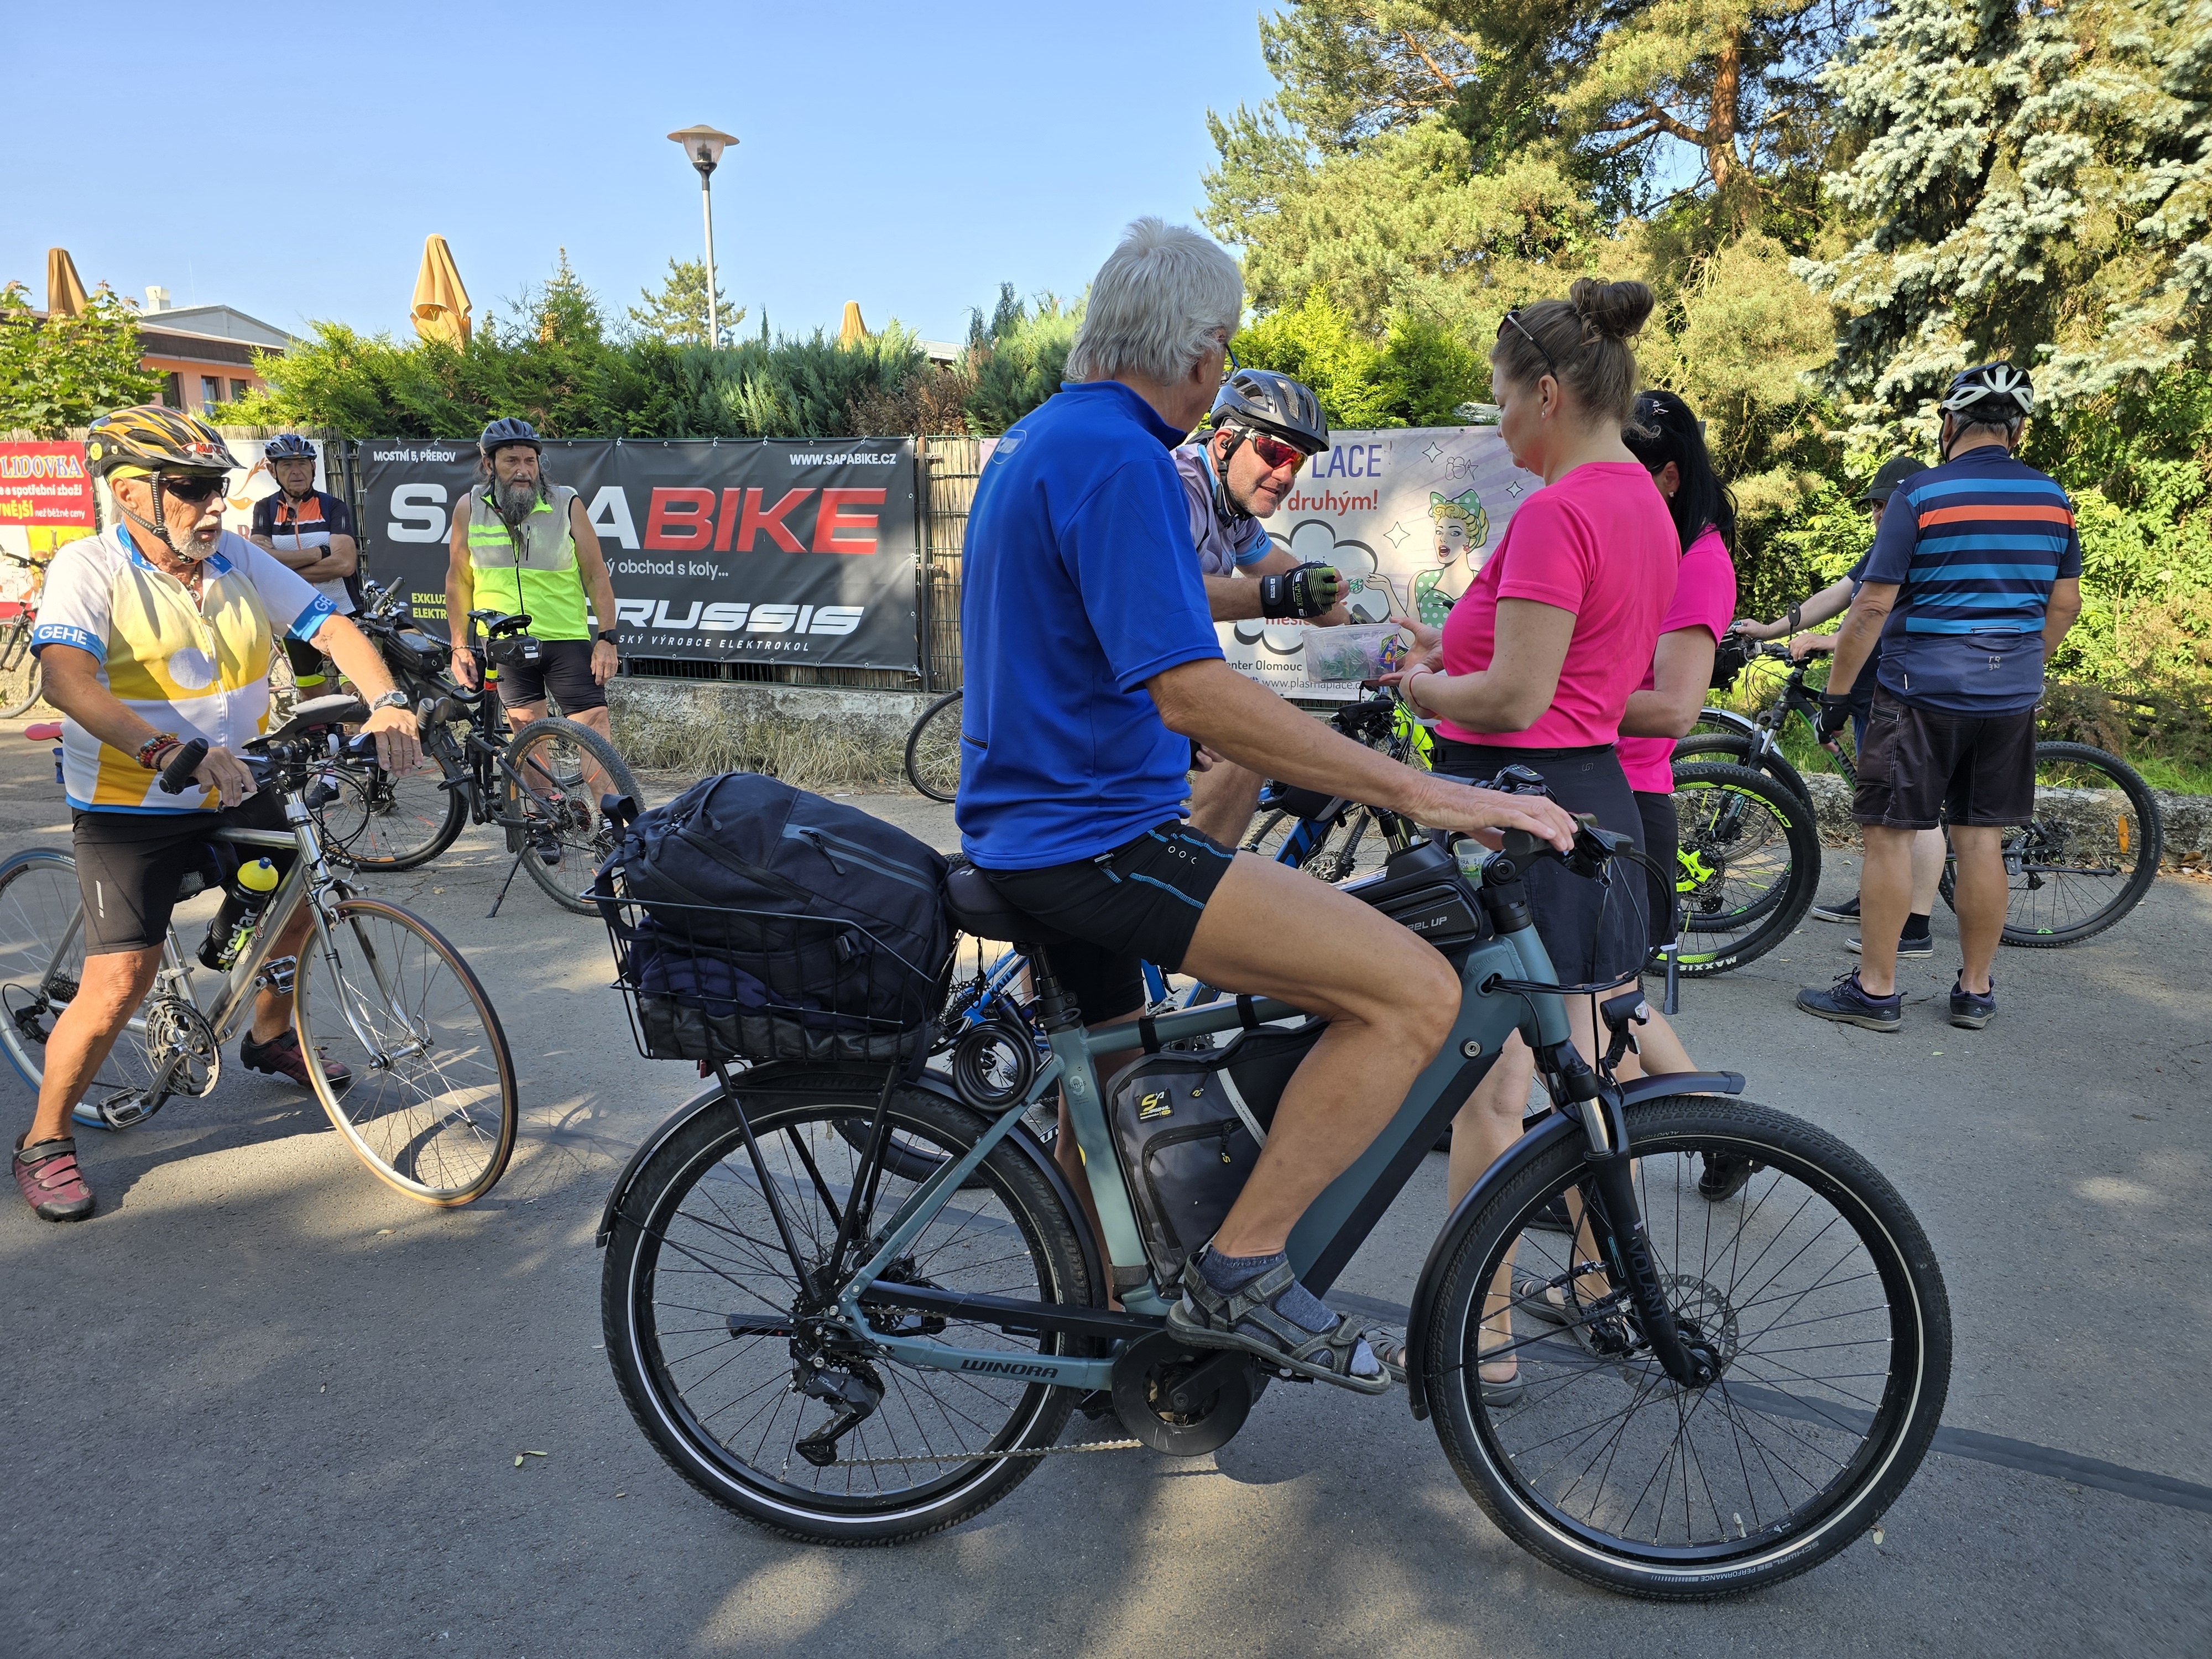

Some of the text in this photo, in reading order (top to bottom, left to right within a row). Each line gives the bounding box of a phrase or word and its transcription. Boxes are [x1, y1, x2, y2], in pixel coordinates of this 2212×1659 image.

[373, 448, 456, 463] MOSTNÍ 5, PŘEROV
[790, 453, 896, 465] WWW.SAPABIKE.CZ
[1295, 444, 1383, 479] LACE
[1, 455, 84, 478] LIDOVKA
[12, 483, 55, 498] spotřební
[57, 483, 82, 496] zboží
[0, 499, 85, 520] NĚJŠÍ než běžné ceny
[1287, 489, 1378, 516] druhým!
[618, 559, 674, 575] obchod
[677, 565, 686, 576] s
[688, 561, 729, 581] koly...
[411, 592, 447, 604] EXKLUZ
[413, 607, 449, 619] ELEKTR
[38, 626, 87, 645] GEHE
[618, 633, 809, 652] SKÝ VÝROBCE ELEKTROKOL
[1256, 660, 1302, 671] Olomouc
[1431, 916, 1447, 927] UP
[1679, 956, 1736, 971] MAXXIS
[1068, 1081, 1087, 1089] sinus
[960, 1359, 1058, 1379] WINORA
[1700, 1541, 1819, 1582] SCHWALBE PERFORMANCE
